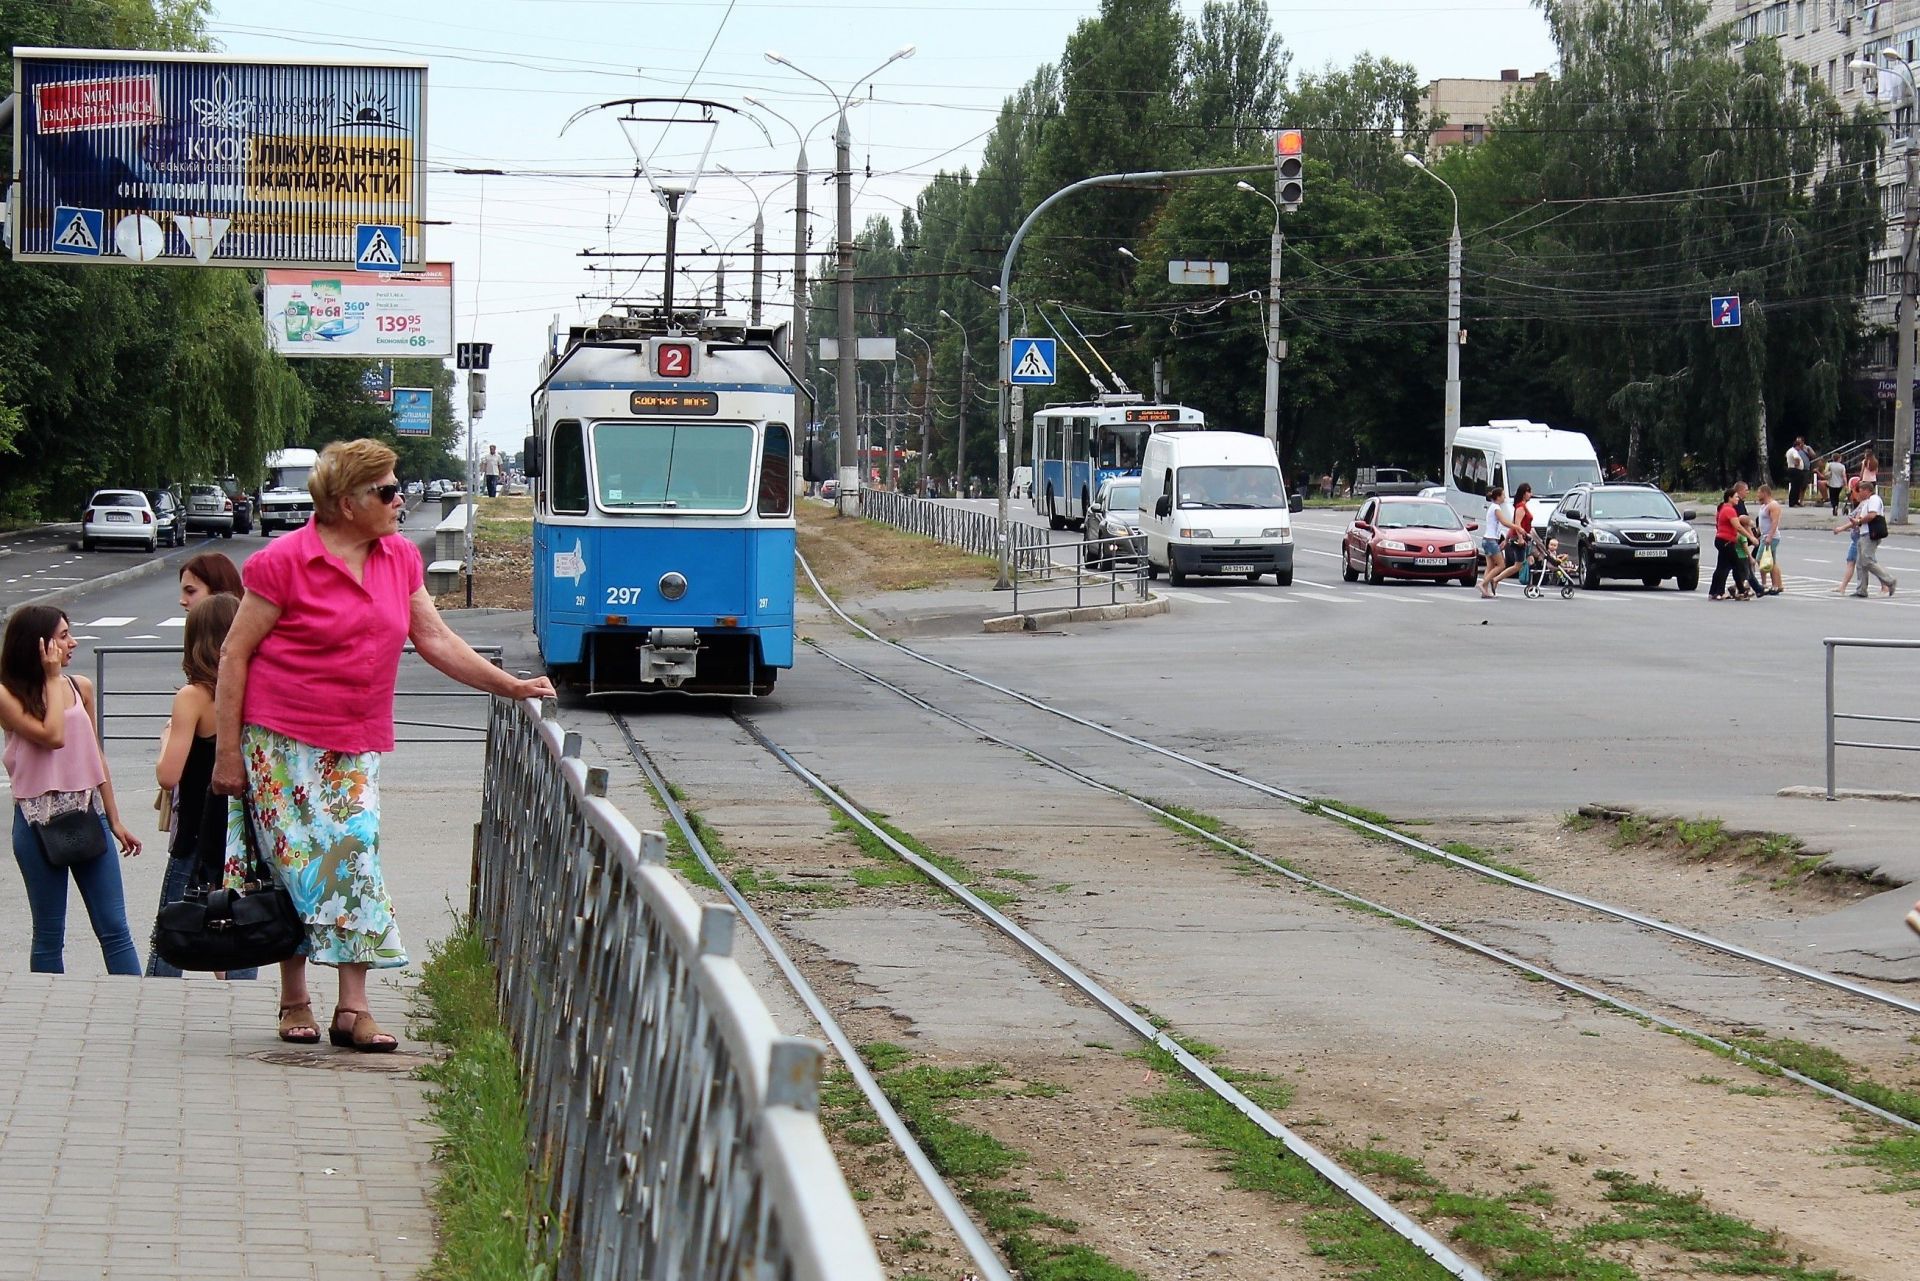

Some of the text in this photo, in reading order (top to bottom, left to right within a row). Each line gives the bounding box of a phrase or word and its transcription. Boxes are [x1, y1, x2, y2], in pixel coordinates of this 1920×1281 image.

[259, 144, 401, 167] ЛІКУВАННЯ
[259, 171, 401, 194] КАТАРАКТИ
[376, 315, 421, 332] 139 95
[409, 335, 427, 346] 68
[666, 349, 683, 371] 2
[575, 595, 586, 607] 297
[606, 586, 642, 605] 297
[759, 597, 769, 609] 297
